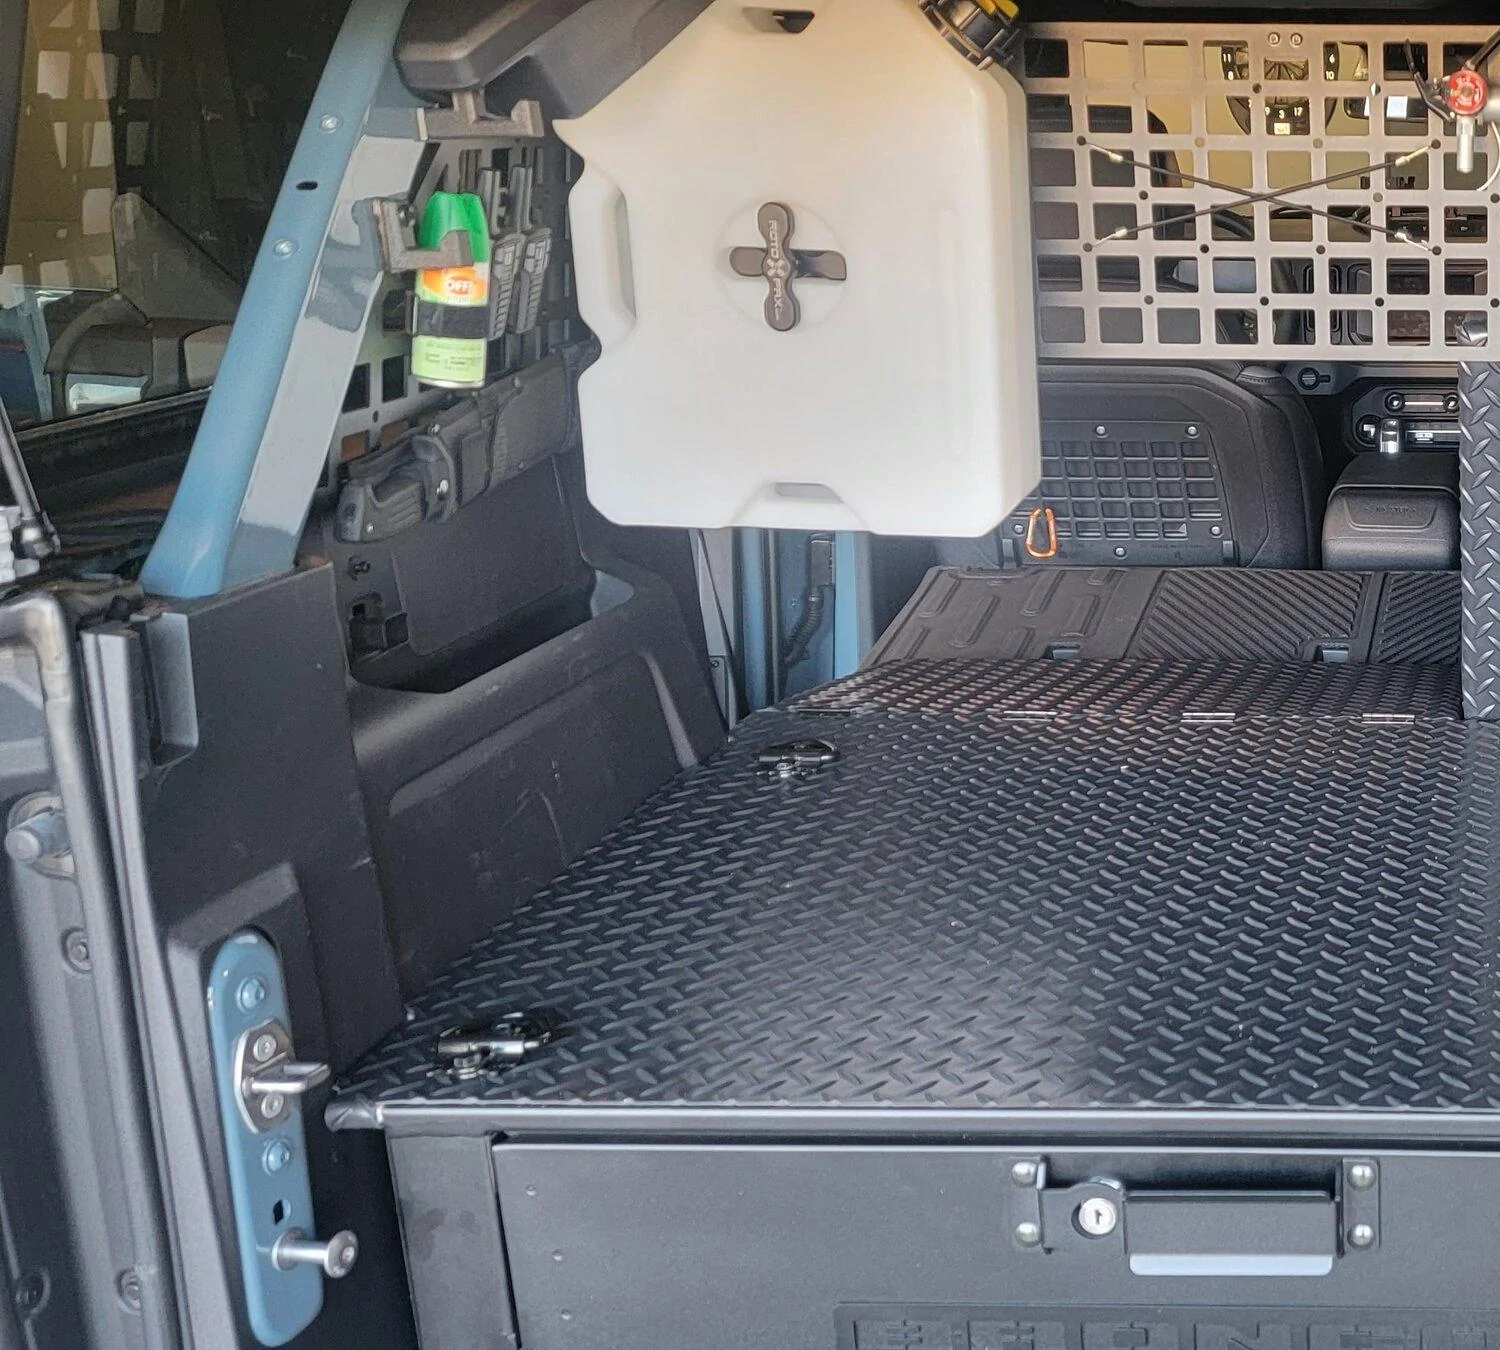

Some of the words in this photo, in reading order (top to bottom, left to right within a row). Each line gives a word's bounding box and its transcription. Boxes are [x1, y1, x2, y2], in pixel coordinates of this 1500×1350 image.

[1223, 54, 1231, 63] 11
[1329, 54, 1336, 63] 6
[1279, 109, 1285, 119] 3
[1294, 107, 1303, 116] 17
